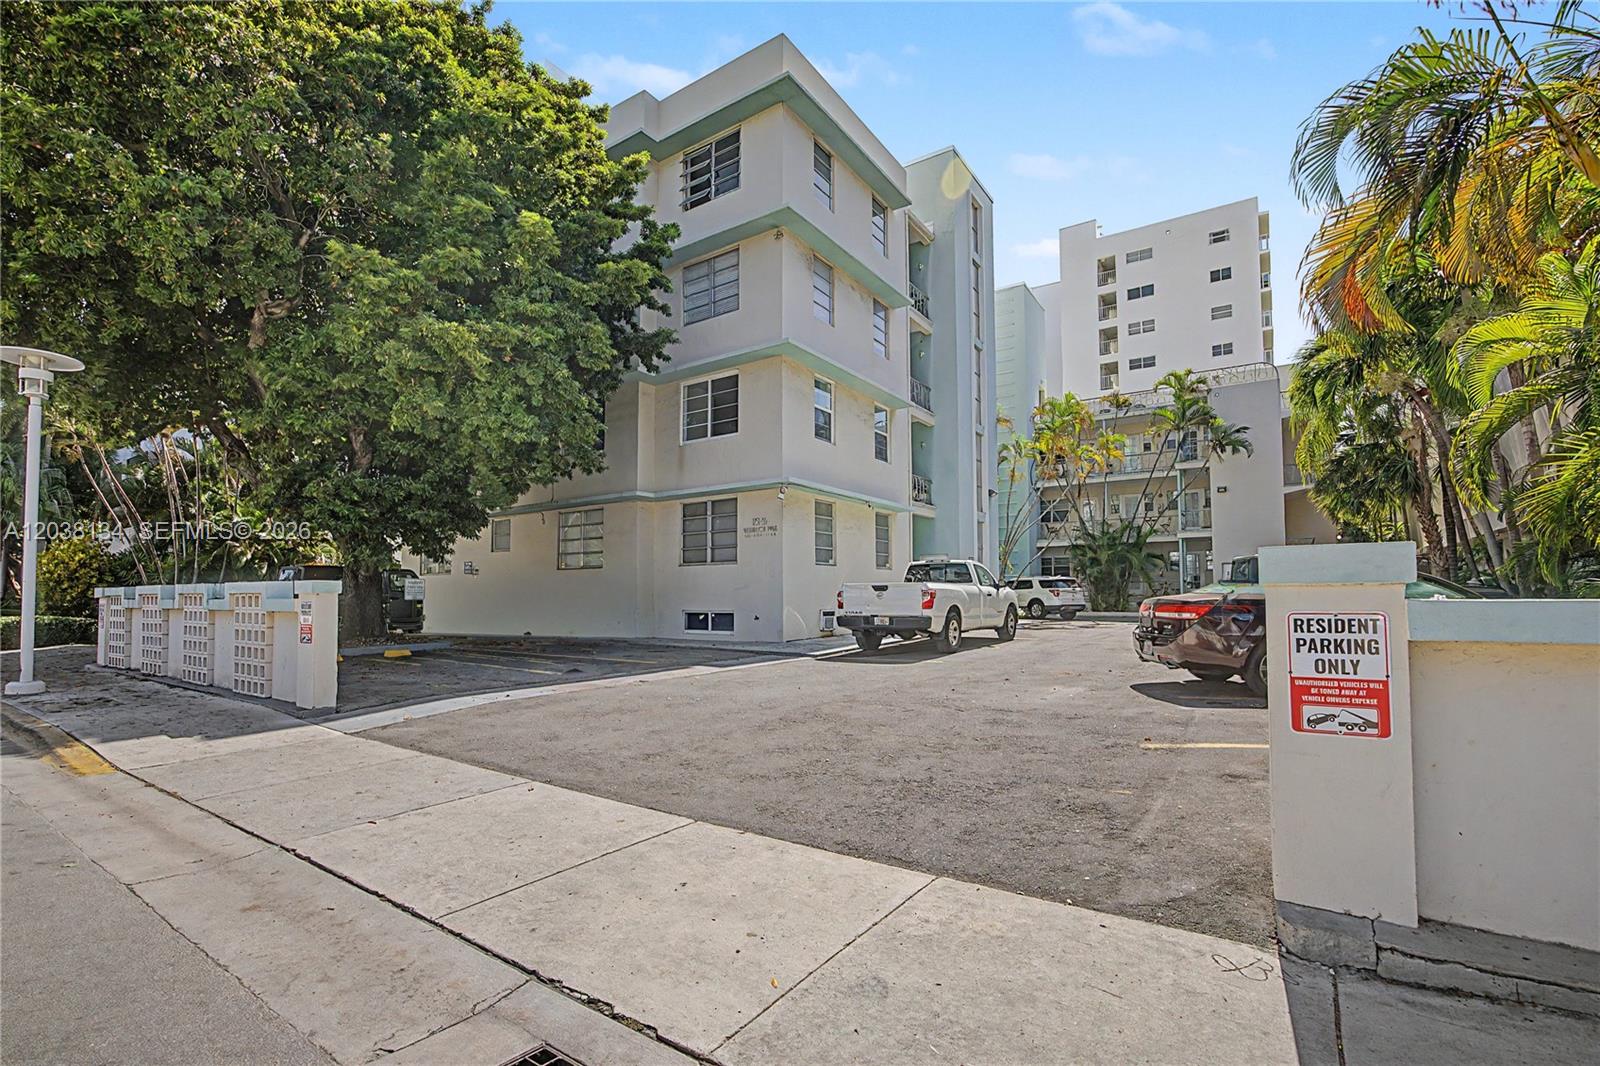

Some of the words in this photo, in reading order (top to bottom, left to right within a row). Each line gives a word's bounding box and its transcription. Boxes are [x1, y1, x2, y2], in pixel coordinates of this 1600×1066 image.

[1293, 618, 1380, 634] RESIDENT
[1295, 638, 1380, 656] PARKING
[1314, 658, 1361, 676] ONLY
[1340, 681, 1369, 689] VEHICLES
